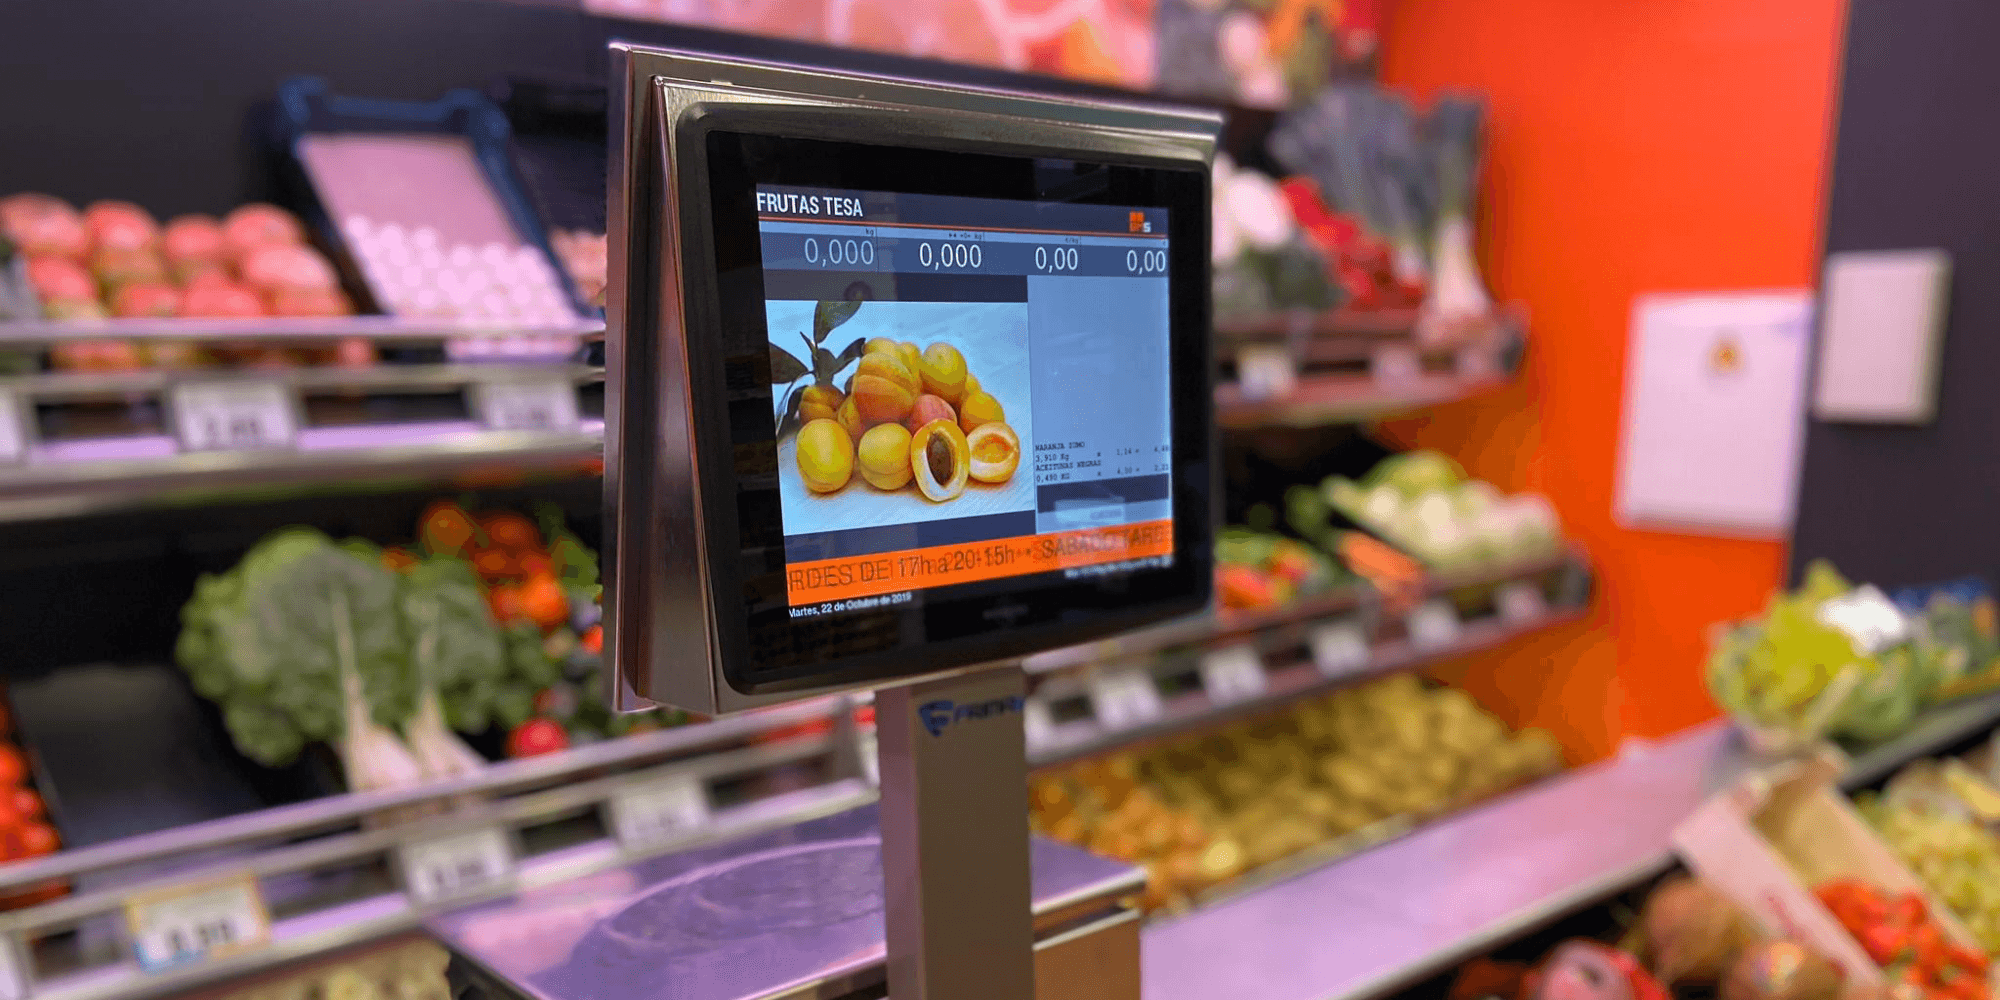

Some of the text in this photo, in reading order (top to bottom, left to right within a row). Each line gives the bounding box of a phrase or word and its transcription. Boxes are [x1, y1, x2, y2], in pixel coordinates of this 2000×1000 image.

[756, 191, 863, 217] FRUTAS TESA
[865, 228, 875, 236] kg
[804, 238, 874, 267] 0,000
[919, 242, 982, 270] 0,000
[1035, 246, 1078, 273] 0,00
[1127, 249, 1166, 274] 0,00
[1035, 442, 1065, 451] NARANJA
[821, 603, 832, 613] 22
[834, 602, 845, 611] de
[846, 597, 879, 610] Octubre
